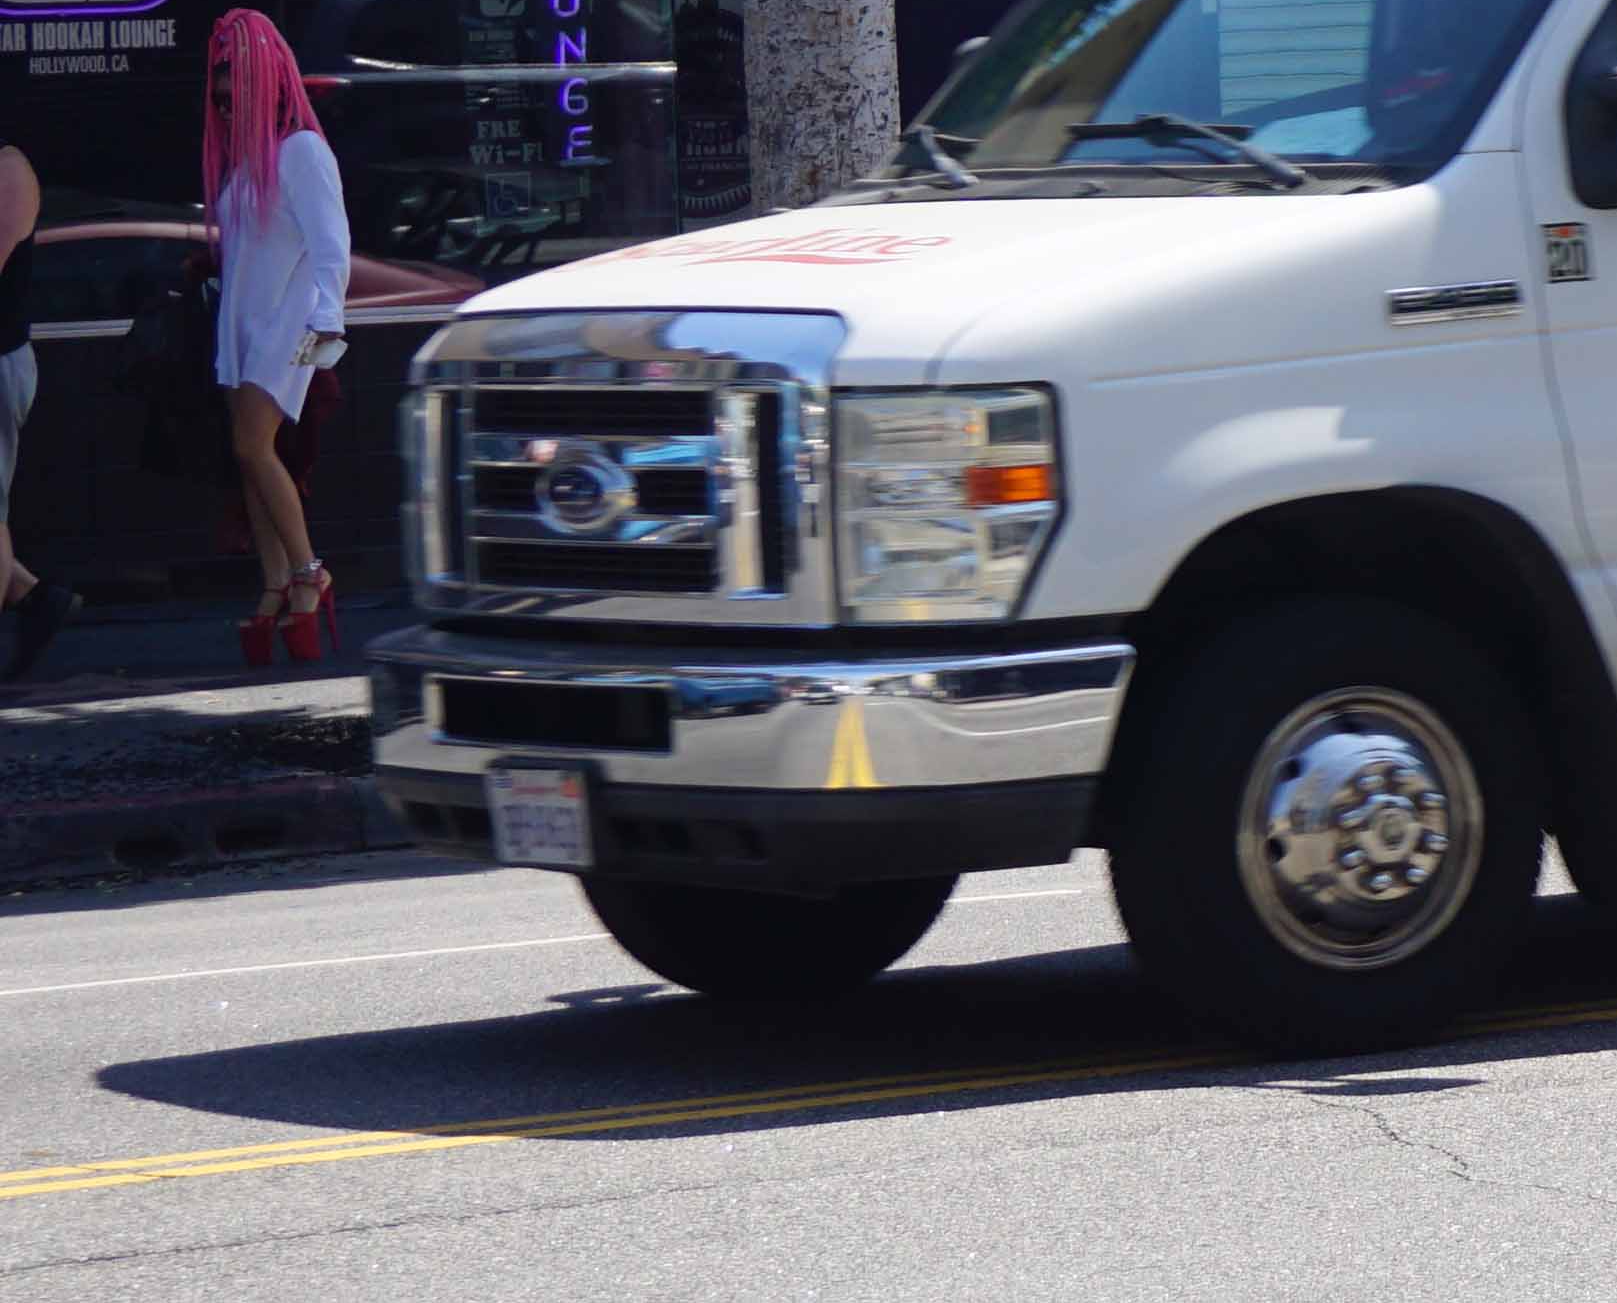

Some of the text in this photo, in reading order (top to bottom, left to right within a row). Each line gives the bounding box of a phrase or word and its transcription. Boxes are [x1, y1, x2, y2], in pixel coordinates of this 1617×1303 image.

[0, 19, 177, 51] AR HOOKAH LOUNGE
[112, 54, 130, 73] CA
